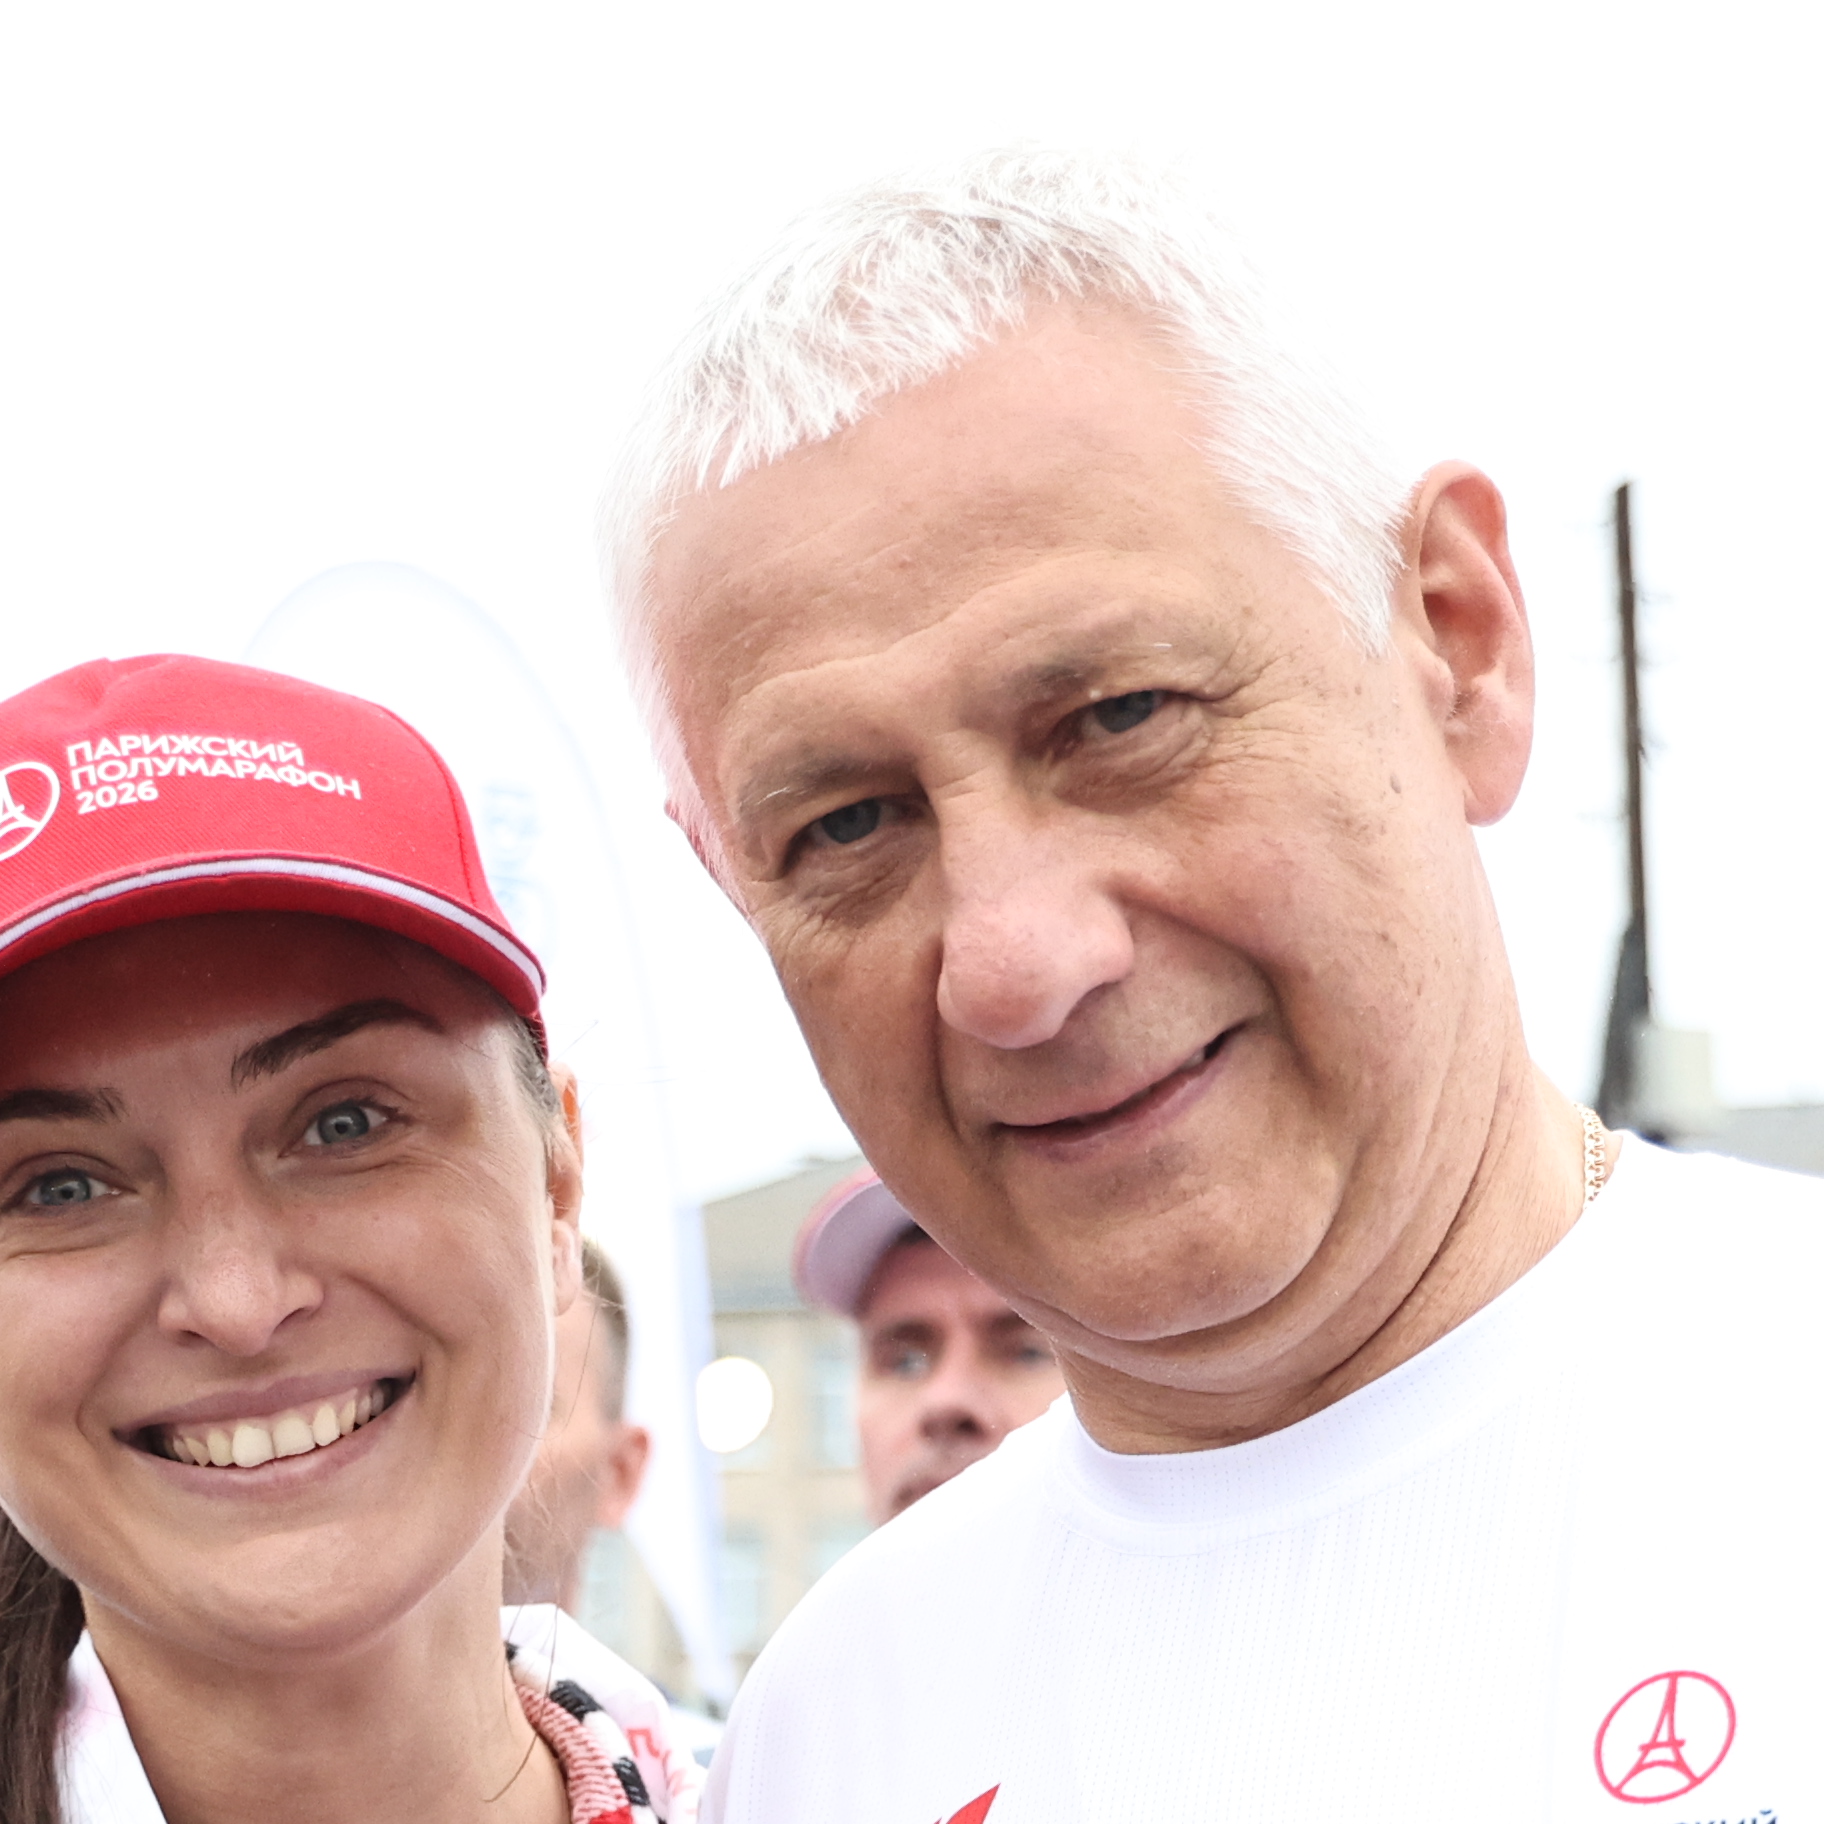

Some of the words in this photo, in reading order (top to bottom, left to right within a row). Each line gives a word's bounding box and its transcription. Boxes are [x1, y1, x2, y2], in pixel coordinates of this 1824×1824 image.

[66, 734, 305, 767] ПАРИЖСКИЙ
[71, 757, 362, 799] ПОЛУМАРАФОН
[78, 780, 159, 814] 2026
